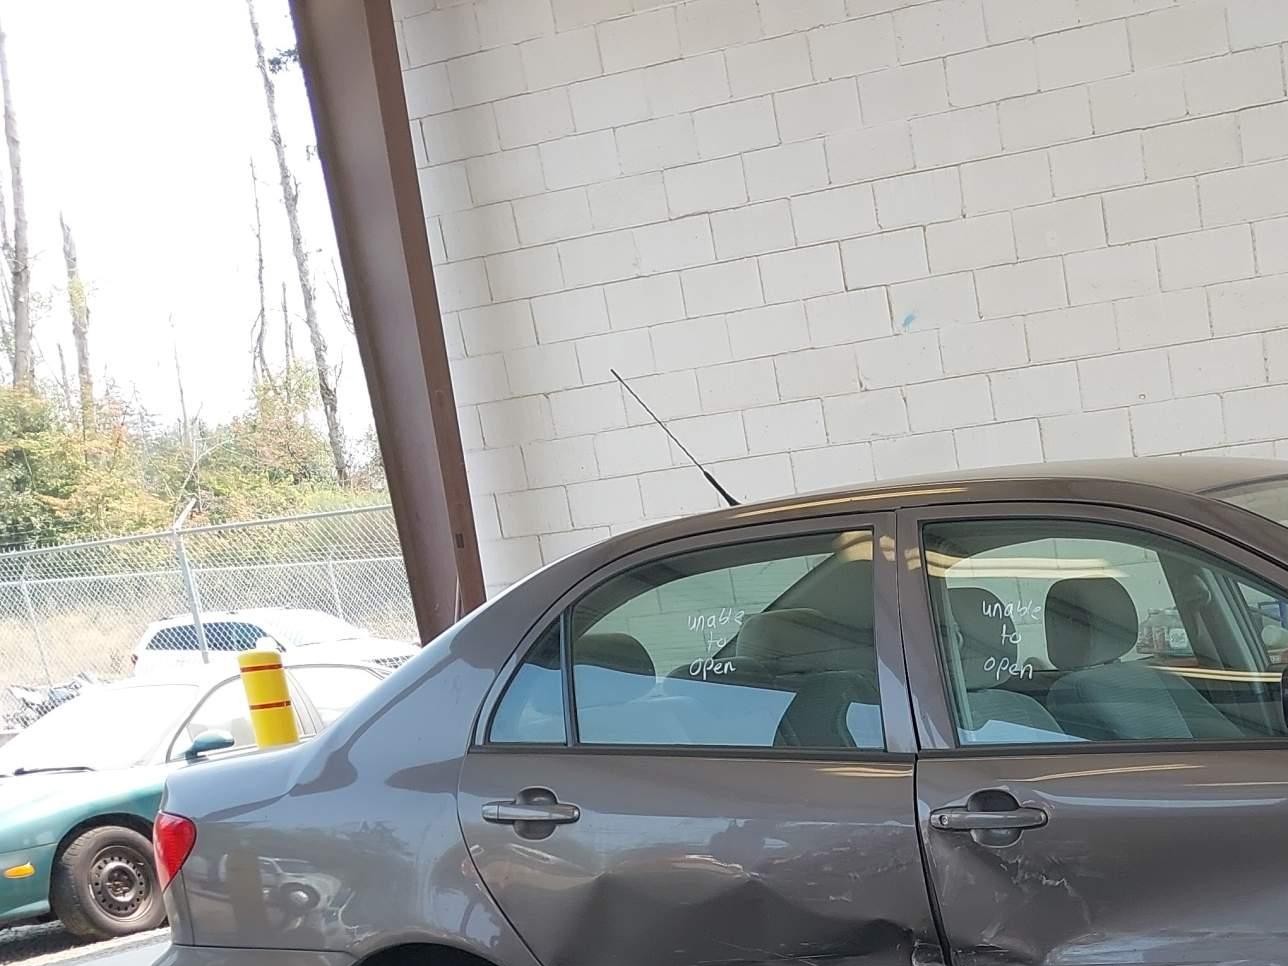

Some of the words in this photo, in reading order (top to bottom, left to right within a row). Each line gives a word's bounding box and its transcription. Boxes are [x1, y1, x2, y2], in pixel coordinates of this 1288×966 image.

[688, 607, 745, 632] unable
[981, 600, 1041, 620] unable
[707, 631, 726, 654] to
[1001, 623, 1022, 646] to
[983, 656, 1033, 680] open
